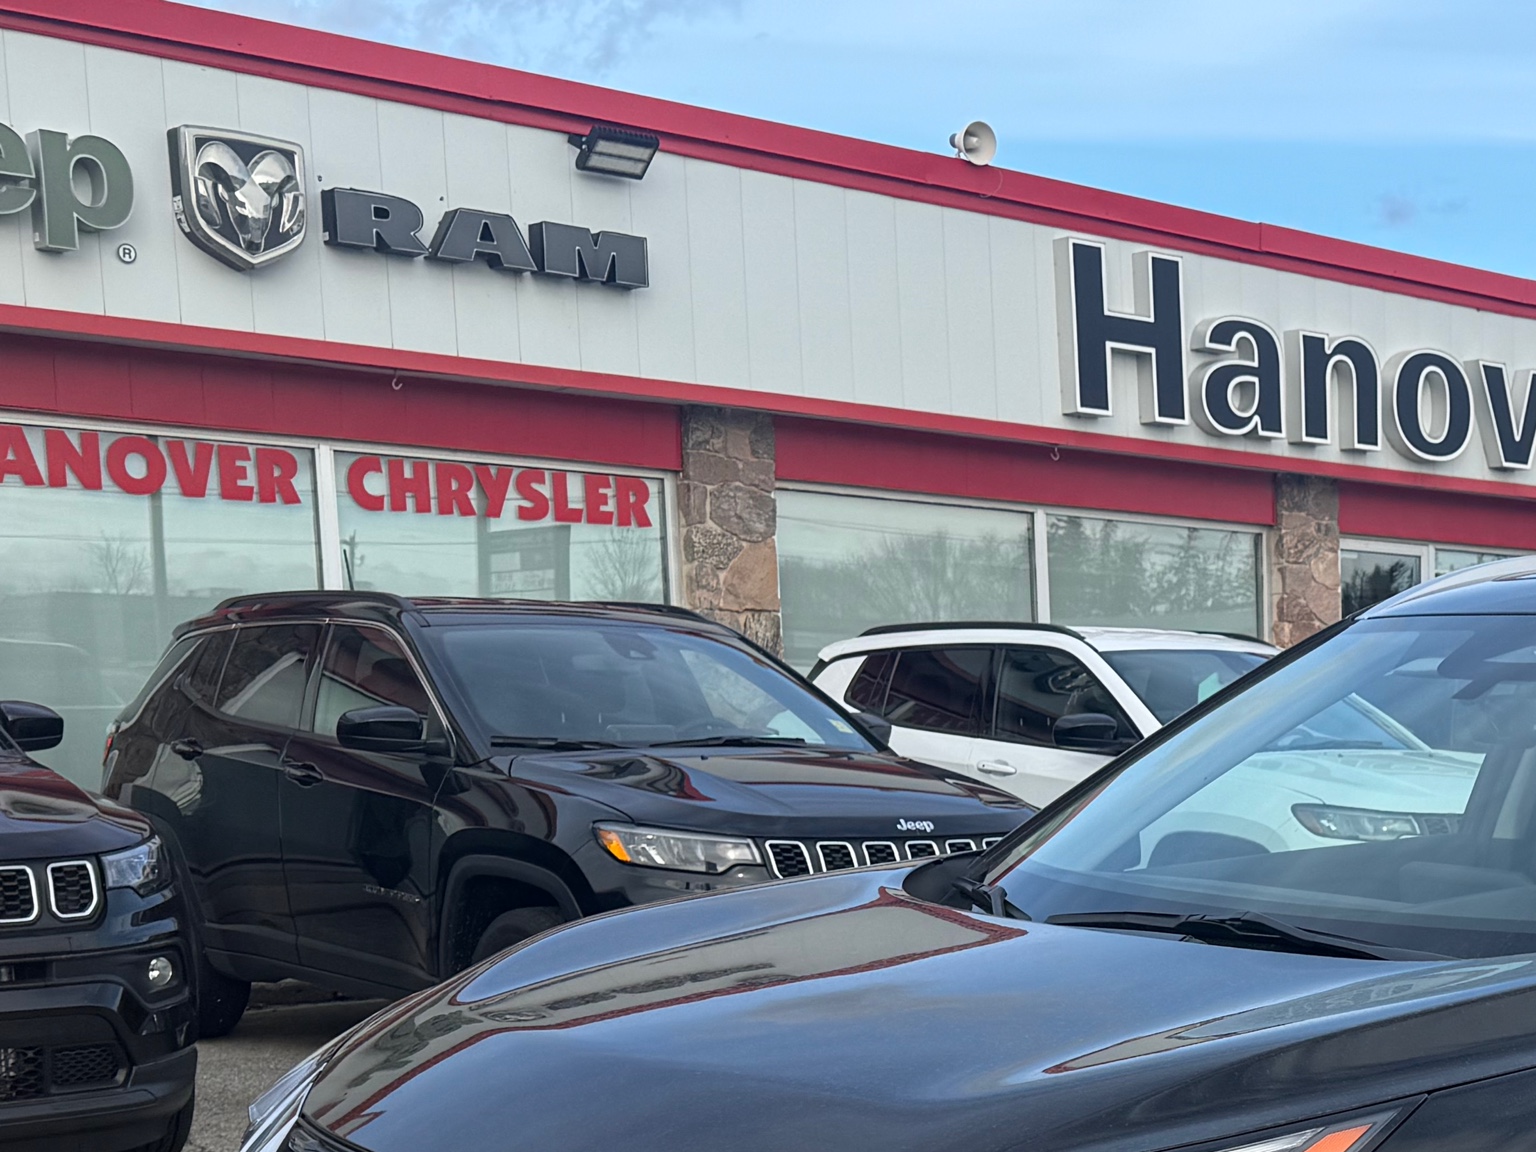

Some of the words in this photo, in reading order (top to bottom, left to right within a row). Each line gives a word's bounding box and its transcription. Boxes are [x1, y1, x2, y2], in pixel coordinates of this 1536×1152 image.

[322, 187, 649, 290] RAM
[346, 455, 653, 528] CHRYSLER
[896, 818, 935, 833] Jeep
